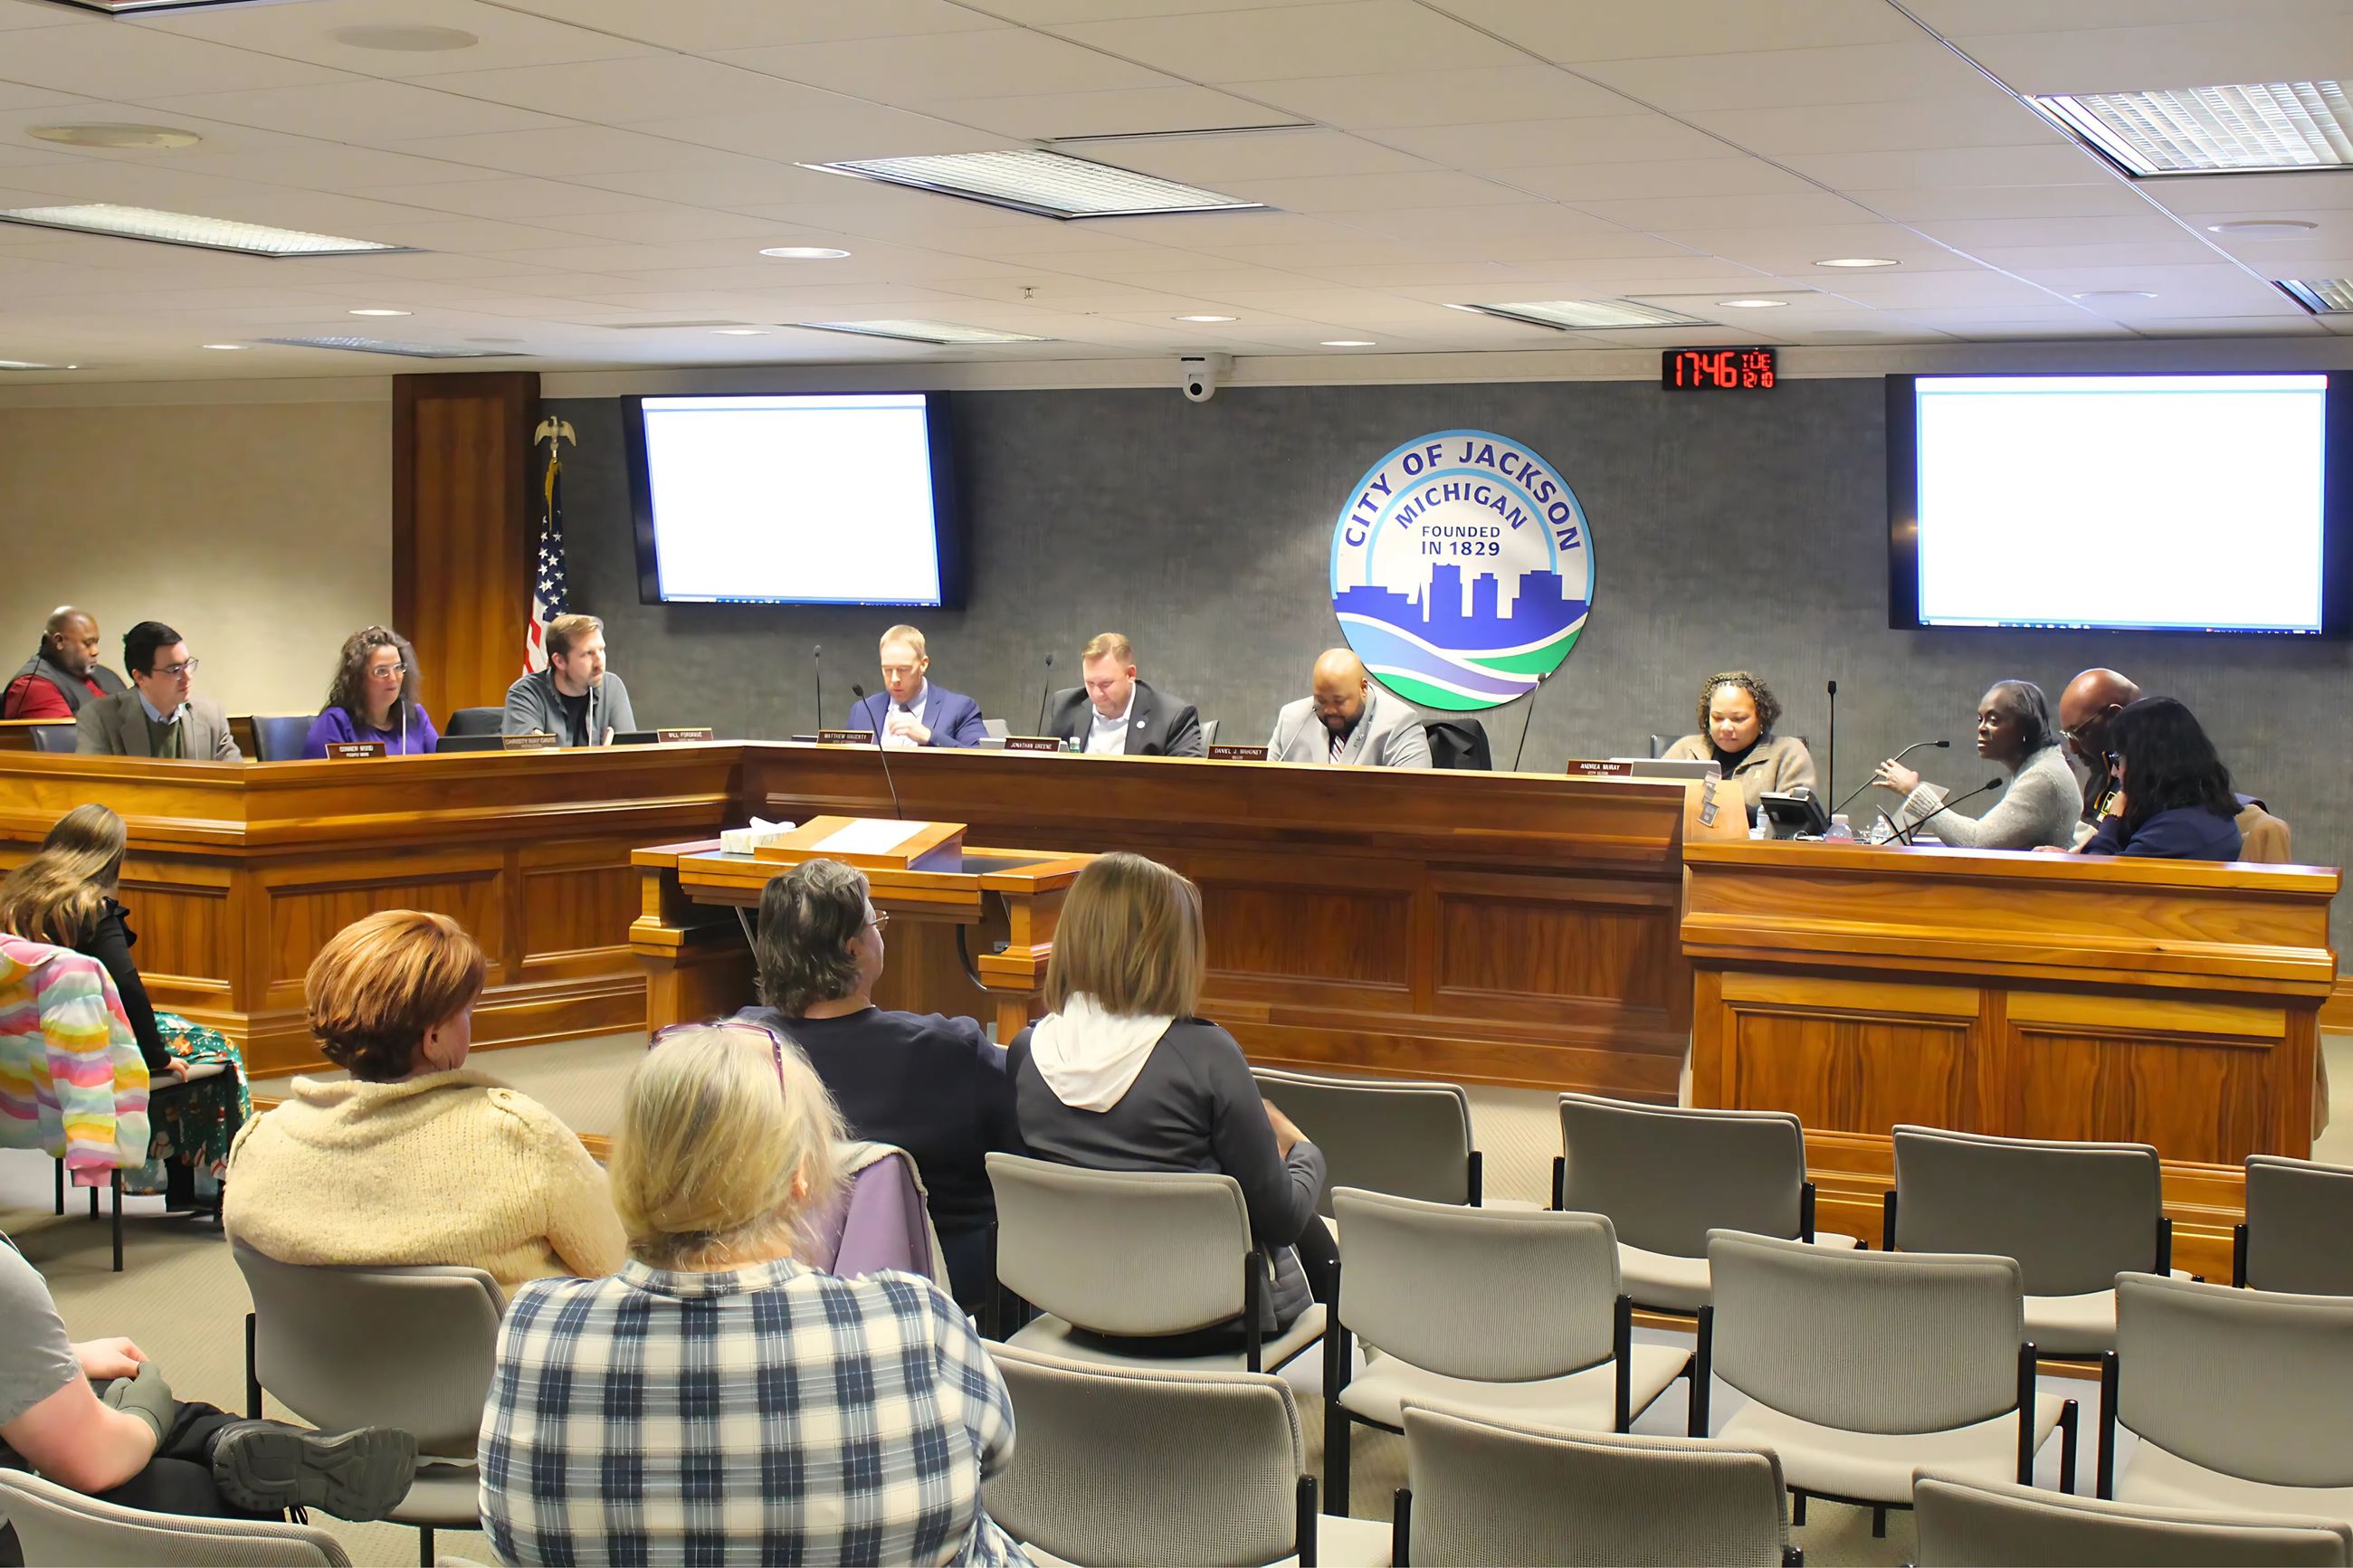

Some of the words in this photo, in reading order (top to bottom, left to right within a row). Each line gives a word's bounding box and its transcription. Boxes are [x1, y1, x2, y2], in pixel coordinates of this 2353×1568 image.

[1676, 351, 1738, 388] 17:46
[1741, 351, 1771, 372] TUE
[1345, 472, 1392, 547] CITY
[1402, 443, 1443, 476] OF
[1459, 442, 1581, 552] JACKSON
[1394, 482, 1529, 531] MICHIGAN
[1422, 526, 1500, 538] FOUNDED
[1422, 541, 1442, 555] IN
[1449, 541, 1500, 556] 1829
